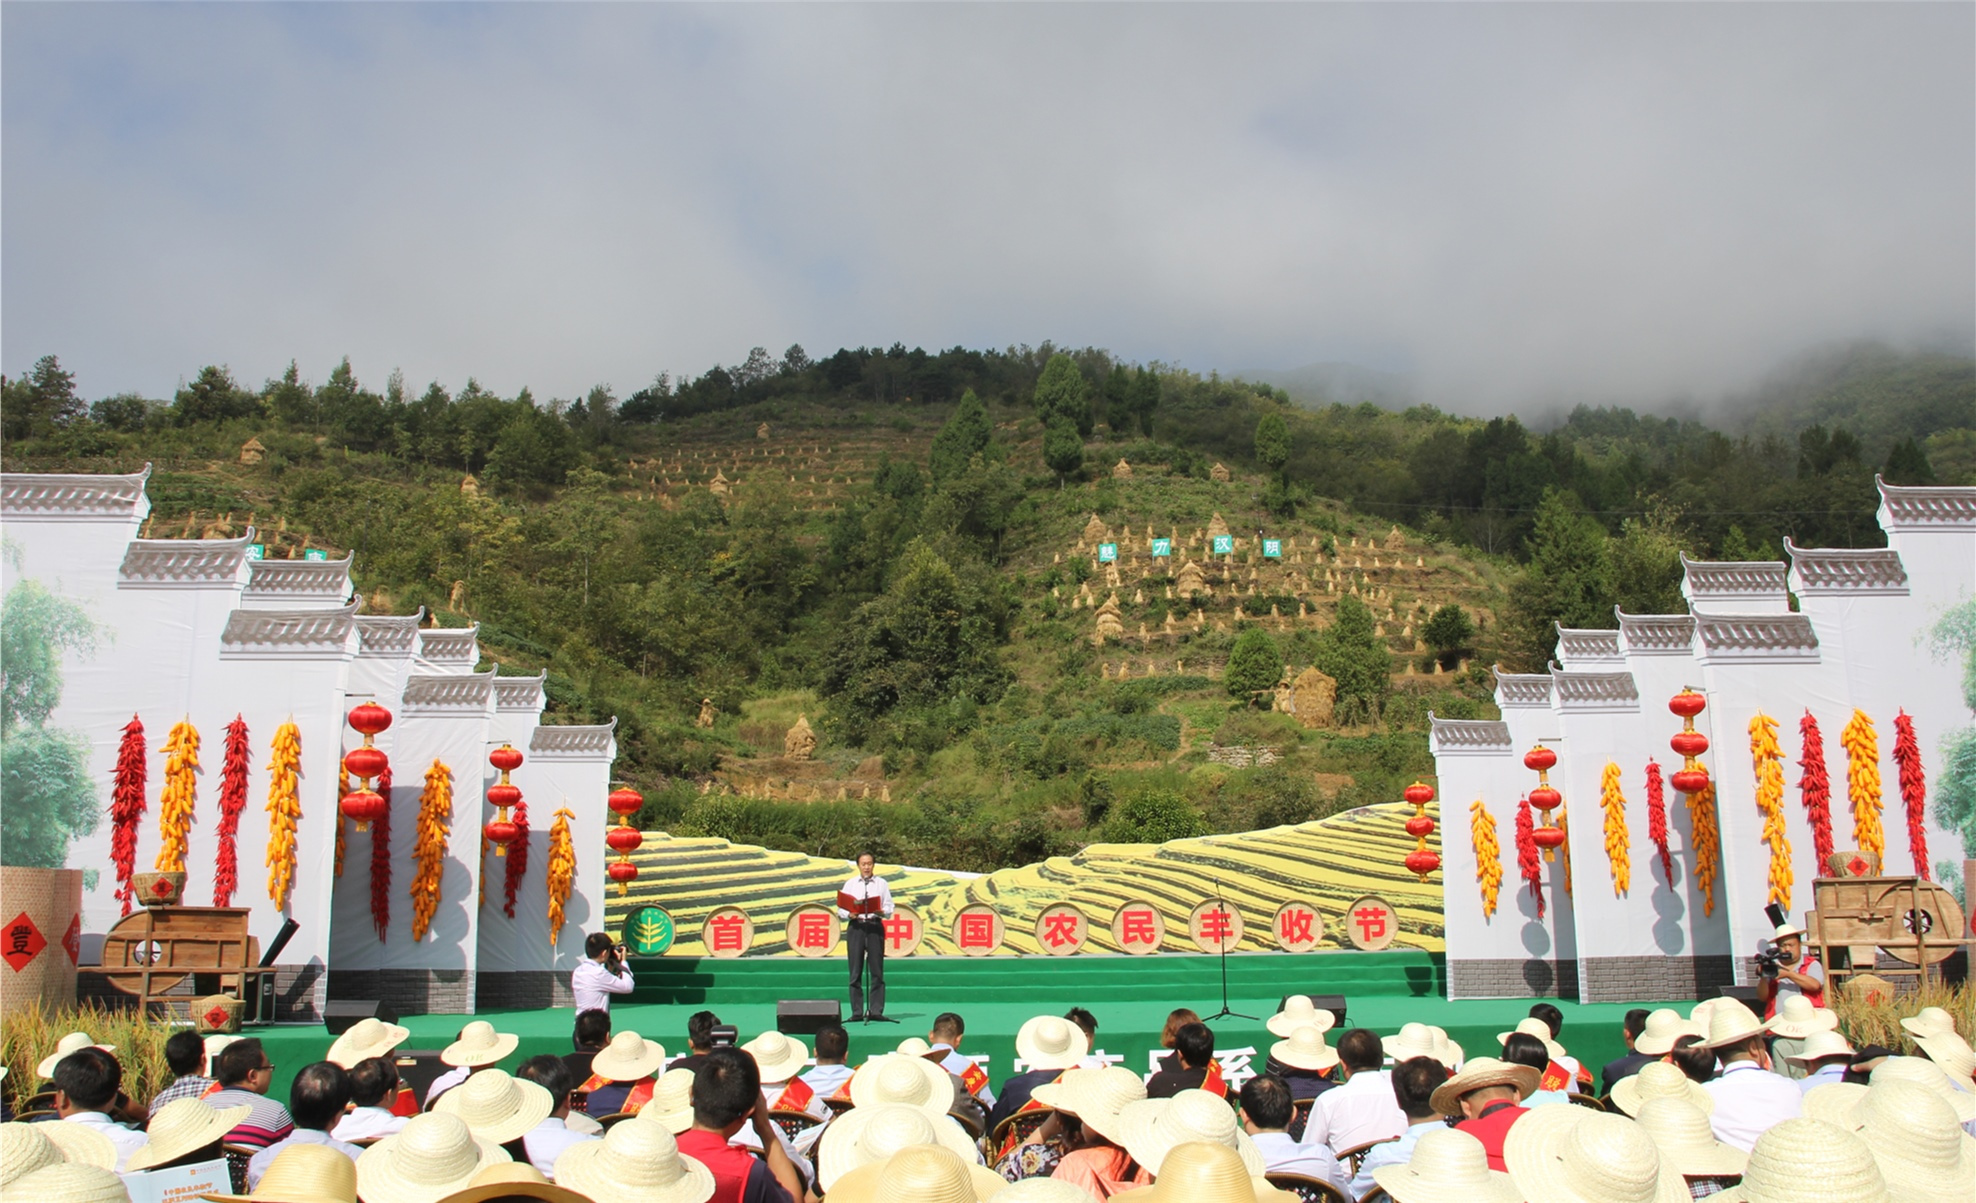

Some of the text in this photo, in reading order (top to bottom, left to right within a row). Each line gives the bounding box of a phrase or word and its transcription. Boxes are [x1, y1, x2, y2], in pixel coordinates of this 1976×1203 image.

[1099, 536, 1280, 560] 魅力汉阴
[709, 907, 1388, 951] 首届中国农民丰收节
